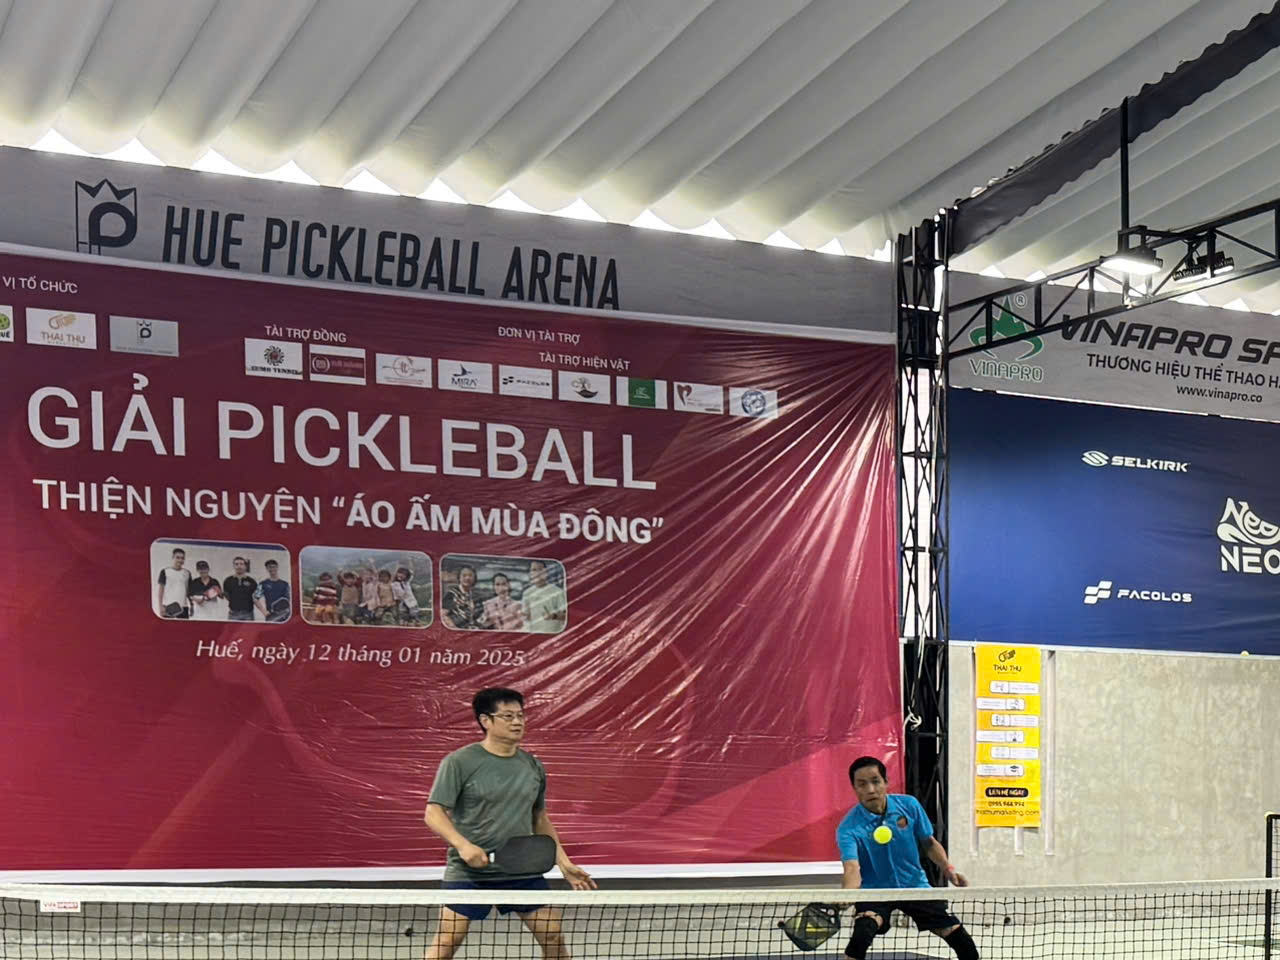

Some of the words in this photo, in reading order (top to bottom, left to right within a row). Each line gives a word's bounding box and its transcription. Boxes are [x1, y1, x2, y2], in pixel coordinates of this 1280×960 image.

[162, 205, 245, 270] HUE
[261, 217, 485, 296] PICKLEBALL
[502, 246, 620, 311] ARENA
[2, 276, 16, 290] VỊ
[40, 279, 78, 294] CHỨC
[264, 324, 283, 337] TÀI
[286, 327, 311, 340] TRỢ
[312, 328, 347, 343] ĐỒNG
[498, 326, 522, 338] ĐƠN
[525, 329, 536, 342] VỊ
[539, 329, 554, 342] TÀI
[557, 332, 580, 346] TRỢ
[539, 351, 556, 363] TÀI
[558, 354, 581, 366] TRỢ
[968, 358, 1043, 383] VINAPRO
[1087, 353, 1151, 373] THƯƠNG
[1154, 360, 1190, 380] HIỆU
[1194, 363, 1224, 382] THỂ
[1225, 370, 1265, 387] THAO
[1176, 385, 1263, 403] www.vinapro.co
[28, 372, 186, 456] GIẢI
[218, 400, 657, 490] PICKLEBALL
[1111, 455, 1189, 472] SELKIRK
[32, 476, 152, 519] THIỆN
[166, 487, 320, 529] NGUYỆN
[405, 494, 460, 533] ẤM
[471, 503, 550, 538] MÙA
[1117, 589, 1193, 603] FACOLOS
[196, 639, 244, 660] Huế,
[252, 643, 300, 664] ngày
[306, 644, 330, 661] 12
[337, 643, 392, 667] tháng
[399, 647, 421, 664] 01
[430, 648, 471, 665] năm
[477, 649, 526, 666] 2025
